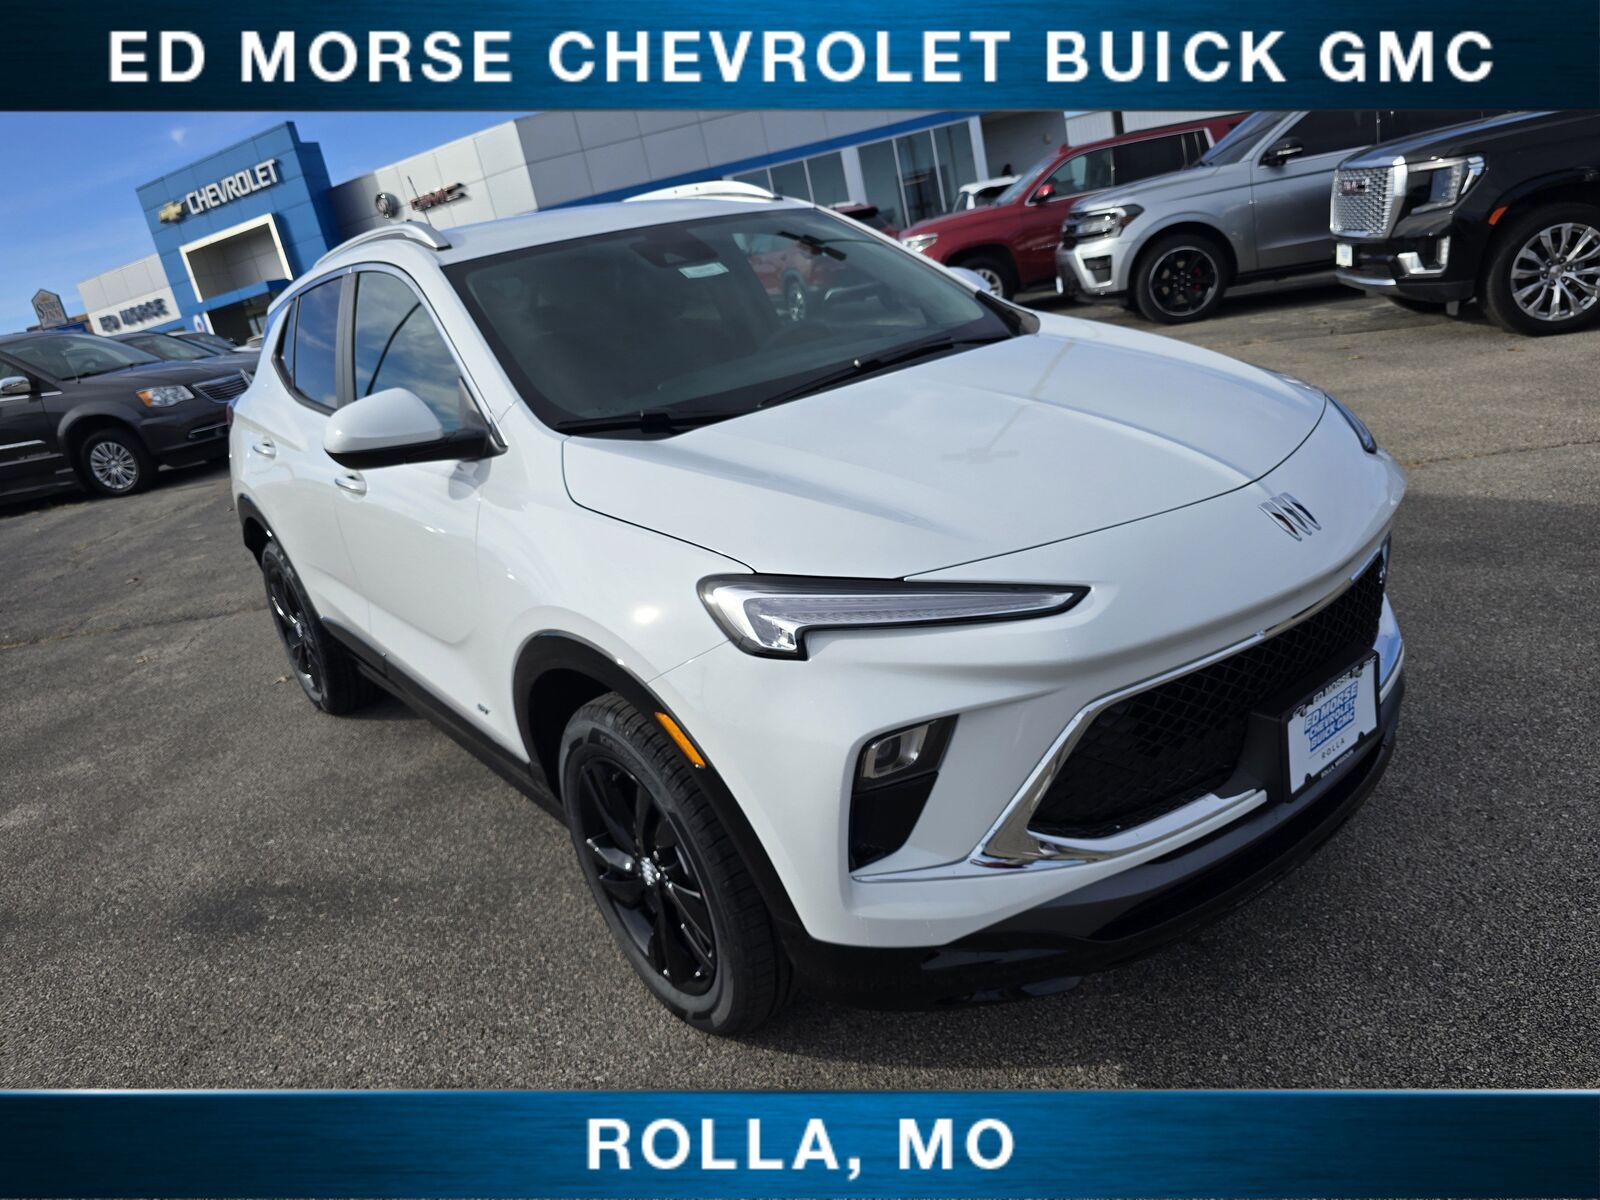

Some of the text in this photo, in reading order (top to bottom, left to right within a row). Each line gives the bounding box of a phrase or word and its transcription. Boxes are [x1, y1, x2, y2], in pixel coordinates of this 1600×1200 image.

[186, 158, 279, 215] CHEVROLET
[1304, 682, 1358, 731] ED MORSE
[1309, 700, 1355, 738] CHEVROLET
[1310, 709, 1355, 749] BUICK GMC
[1321, 738, 1345, 759] ROLLA
